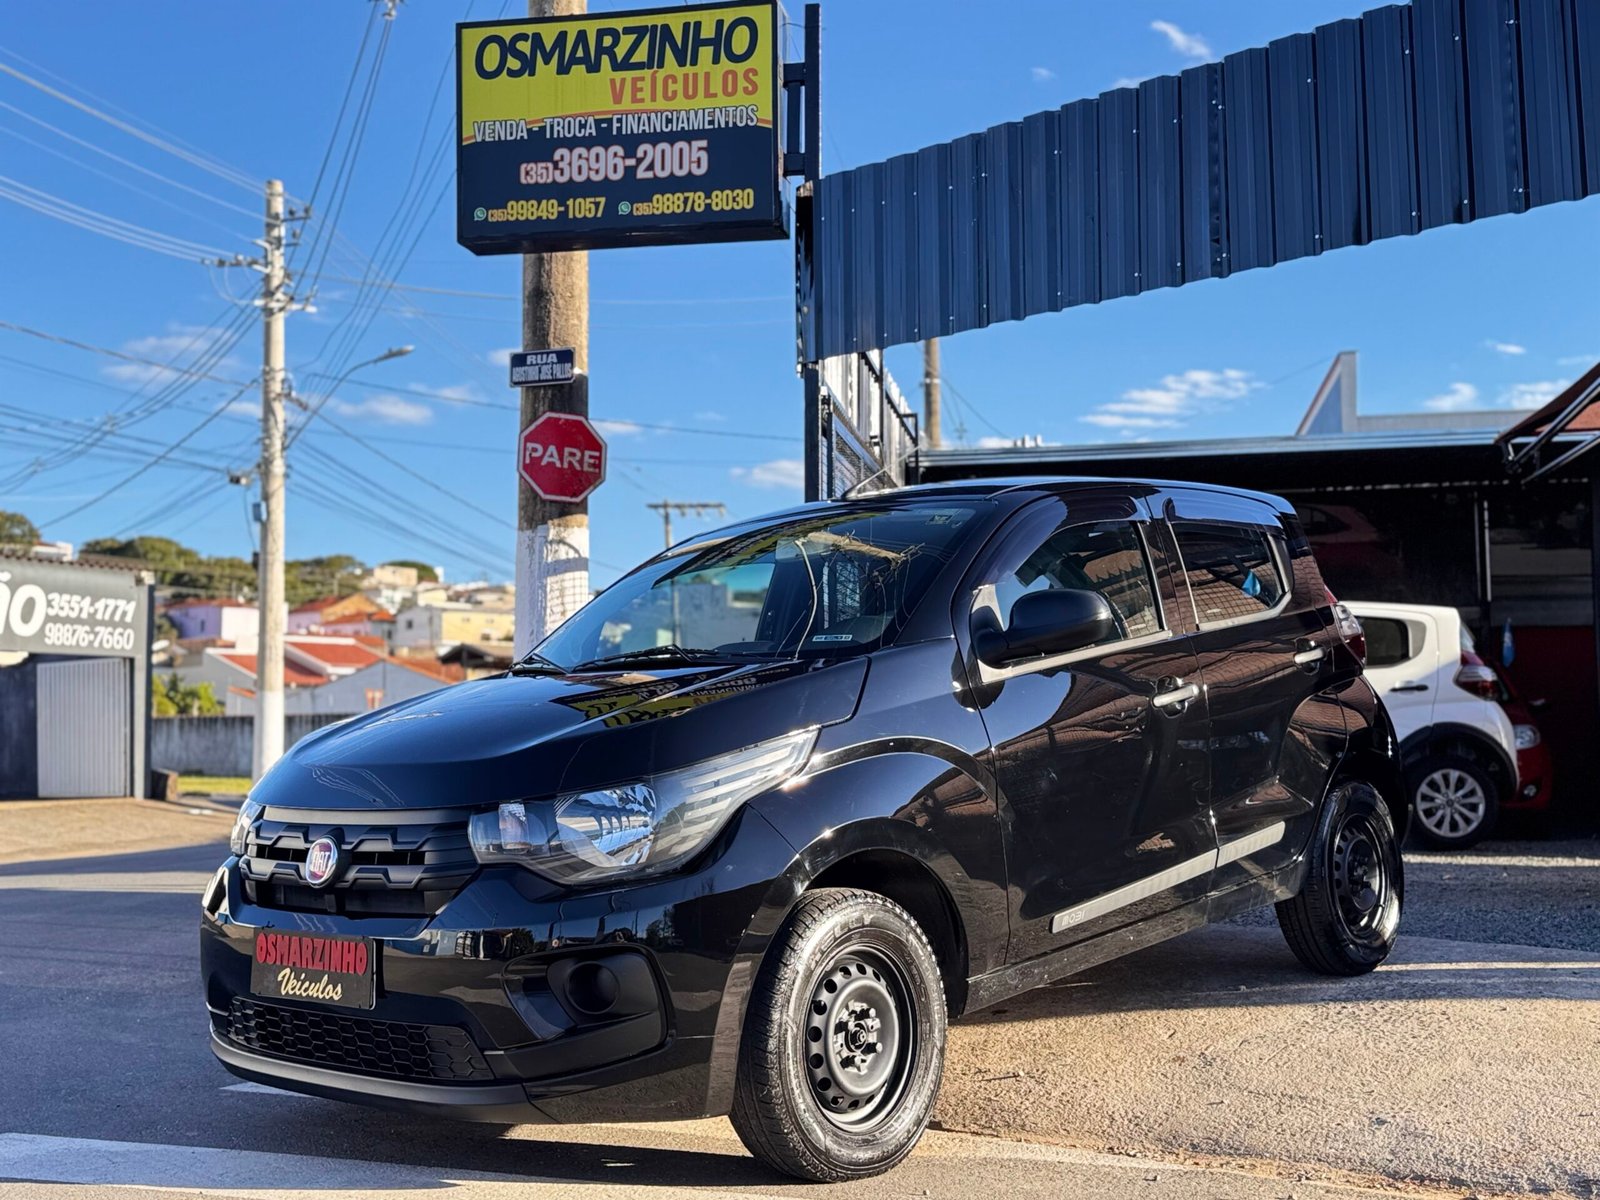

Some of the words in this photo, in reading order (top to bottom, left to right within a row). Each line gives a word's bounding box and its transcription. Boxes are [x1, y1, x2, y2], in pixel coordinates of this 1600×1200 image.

[474, 16, 759, 80] OSMARZINHO
[609, 67, 759, 105] VEÍCULOS
[474, 119, 528, 142] VENDA
[543, 116, 596, 139] TROCA
[612, 105, 758, 135] FINANCIAMENTOS
[526, 353, 558, 365] RUA
[524, 442, 601, 474] PARE
[255, 933, 368, 976] OSMARZINHO
